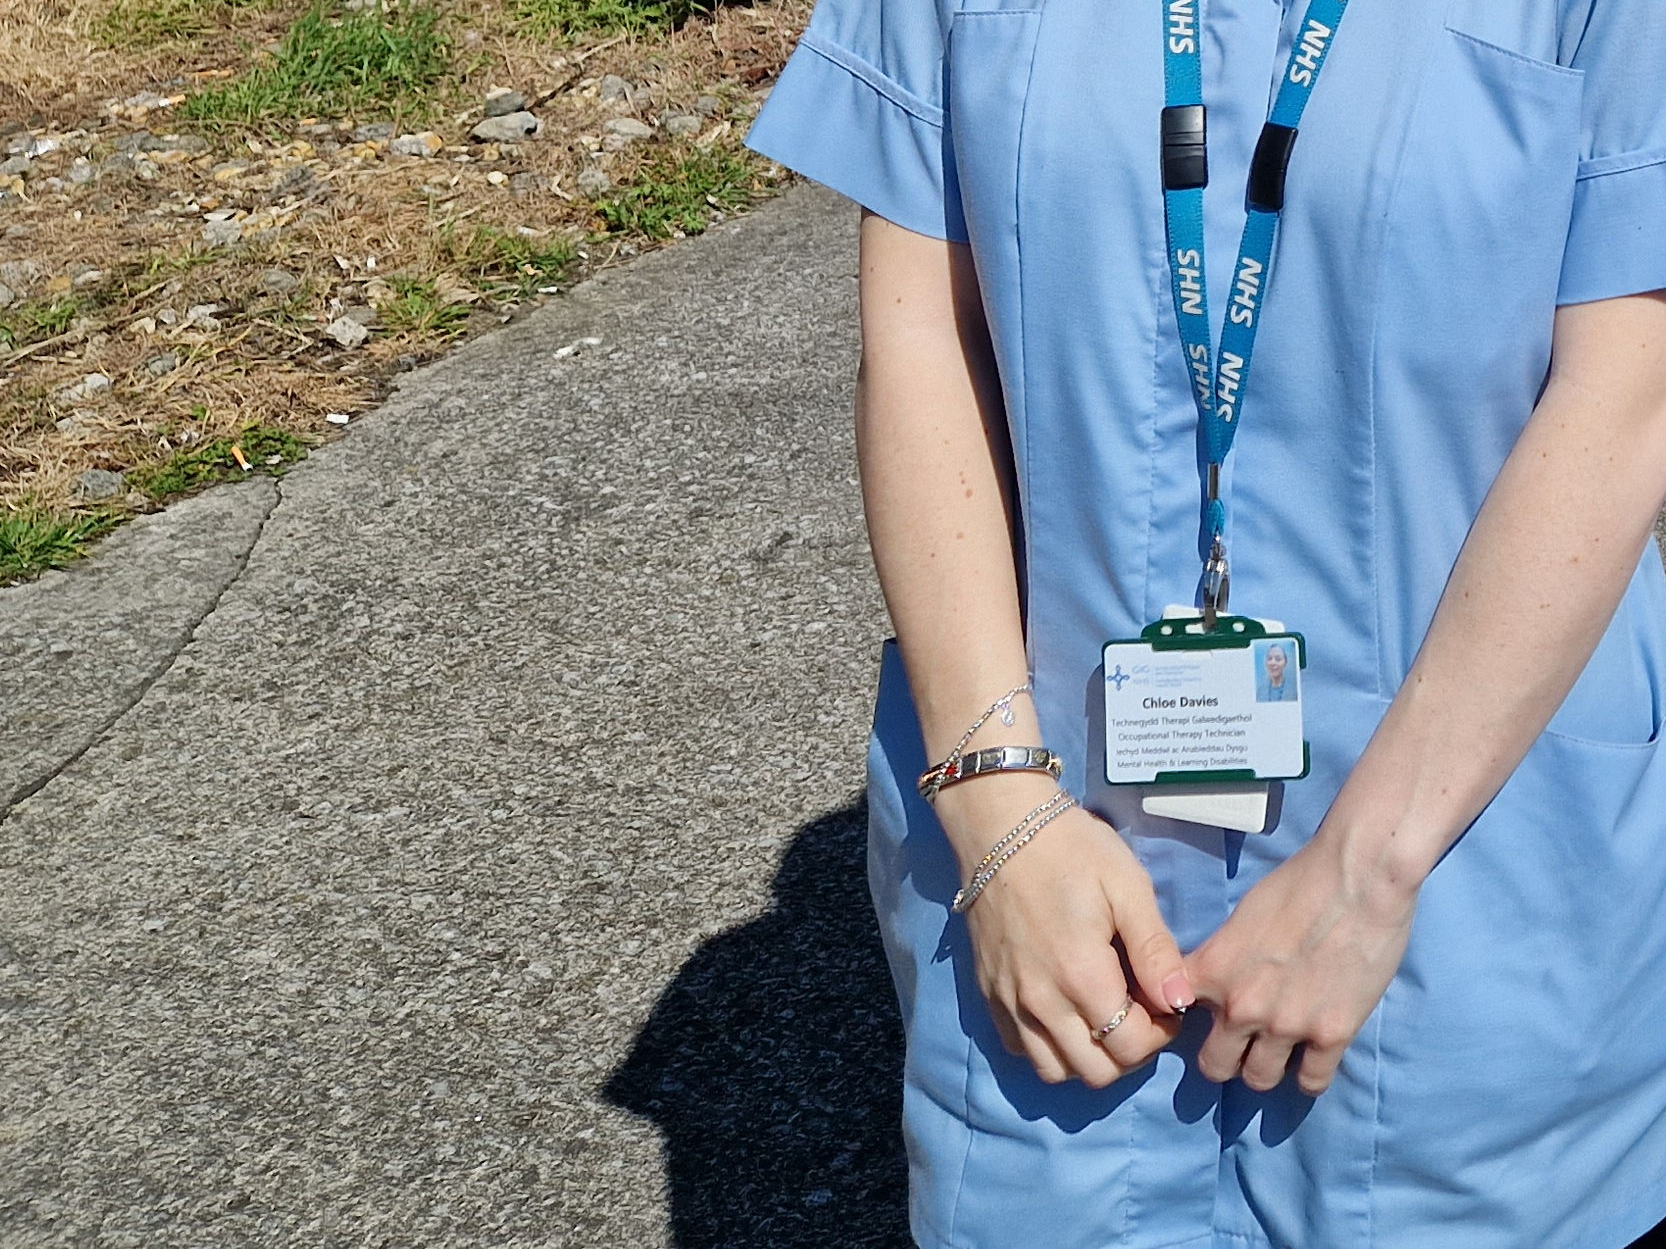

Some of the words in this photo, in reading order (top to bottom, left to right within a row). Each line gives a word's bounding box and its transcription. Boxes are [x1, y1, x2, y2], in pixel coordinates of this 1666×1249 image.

[1290, 19, 1331, 87] NHS
[1177, 248, 1202, 315] NHS
[1230, 257, 1263, 328] NHS
[1189, 343, 1211, 410] NHS
[1217, 351, 1244, 423] NHS
[1118, 731, 1169, 742] Occupational
[1172, 730, 1202, 740] Therapy
[1205, 729, 1246, 738] Technician
[1142, 697, 1177, 709] Chloe
[1179, 695, 1219, 708] Davies
[1161, 716, 1190, 727] Therapi
[1144, 759, 1168, 767] Health
[1178, 758, 1208, 768] Learning
